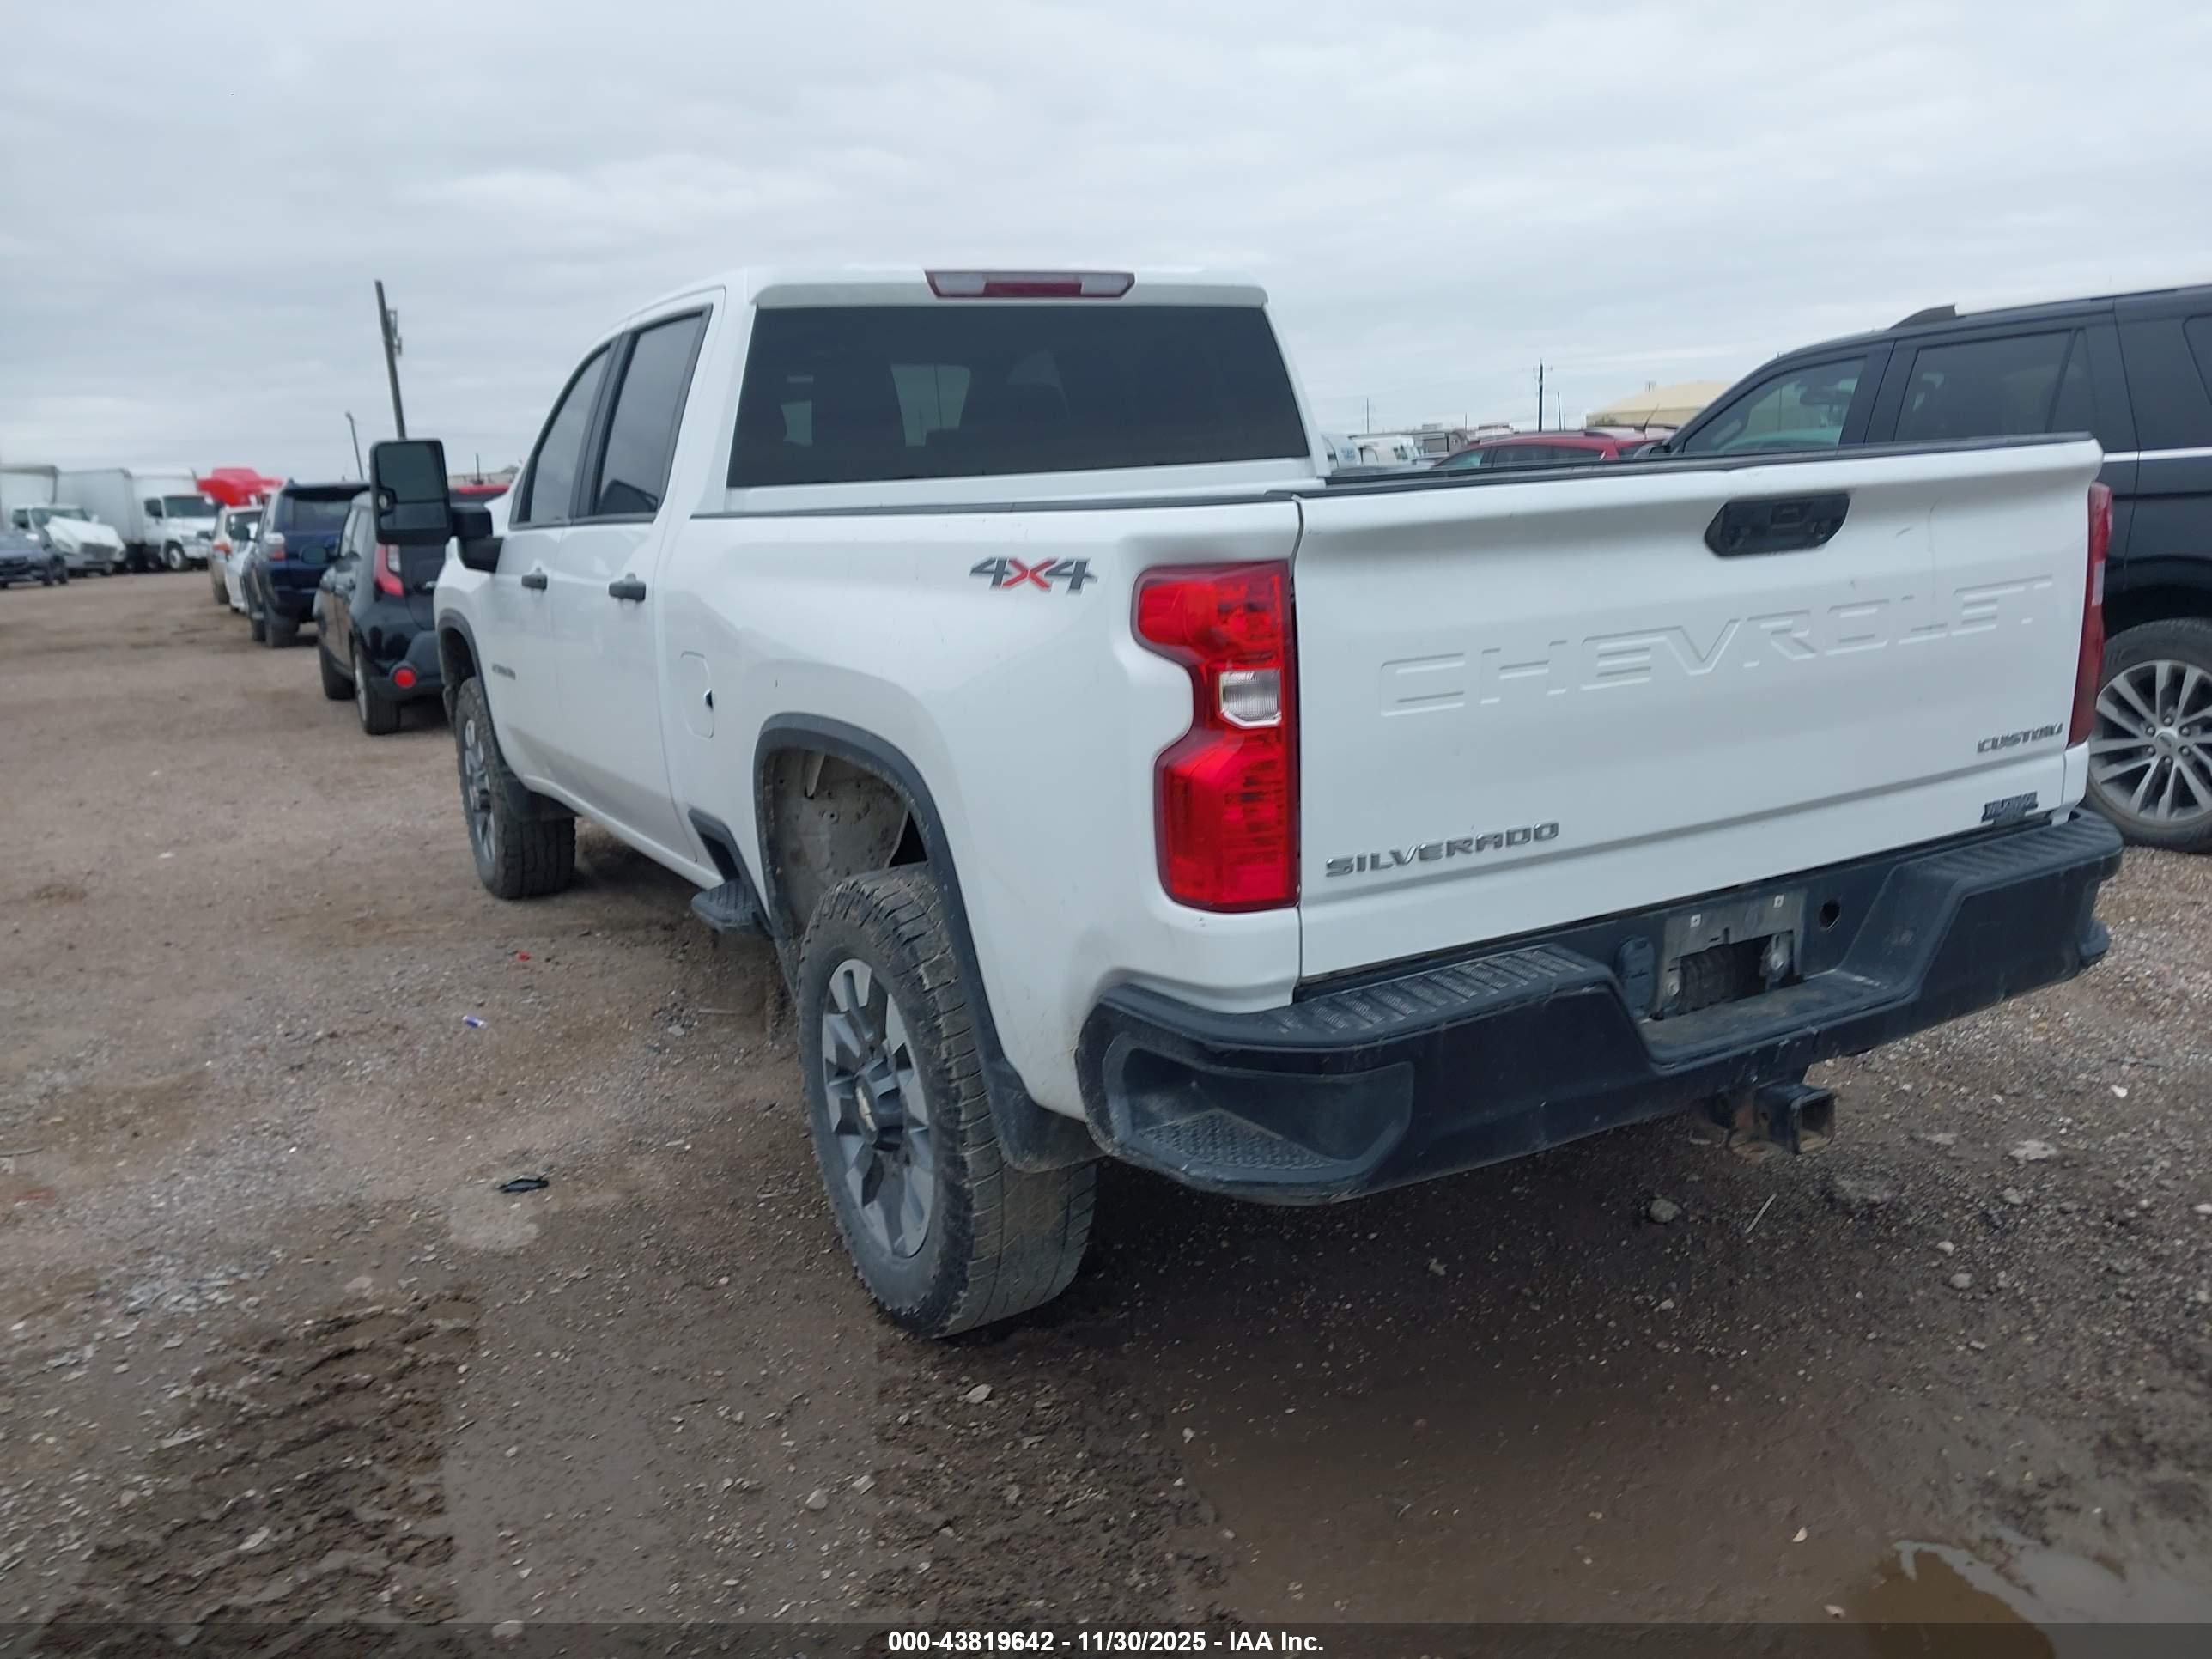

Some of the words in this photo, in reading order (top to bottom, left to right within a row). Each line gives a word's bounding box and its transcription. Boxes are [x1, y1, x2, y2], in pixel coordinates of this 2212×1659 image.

[1379, 574, 2054, 718] CHEVROLET
[1978, 722, 2063, 753] CUSTOM
[1325, 821, 1559, 878] SILVERADO
